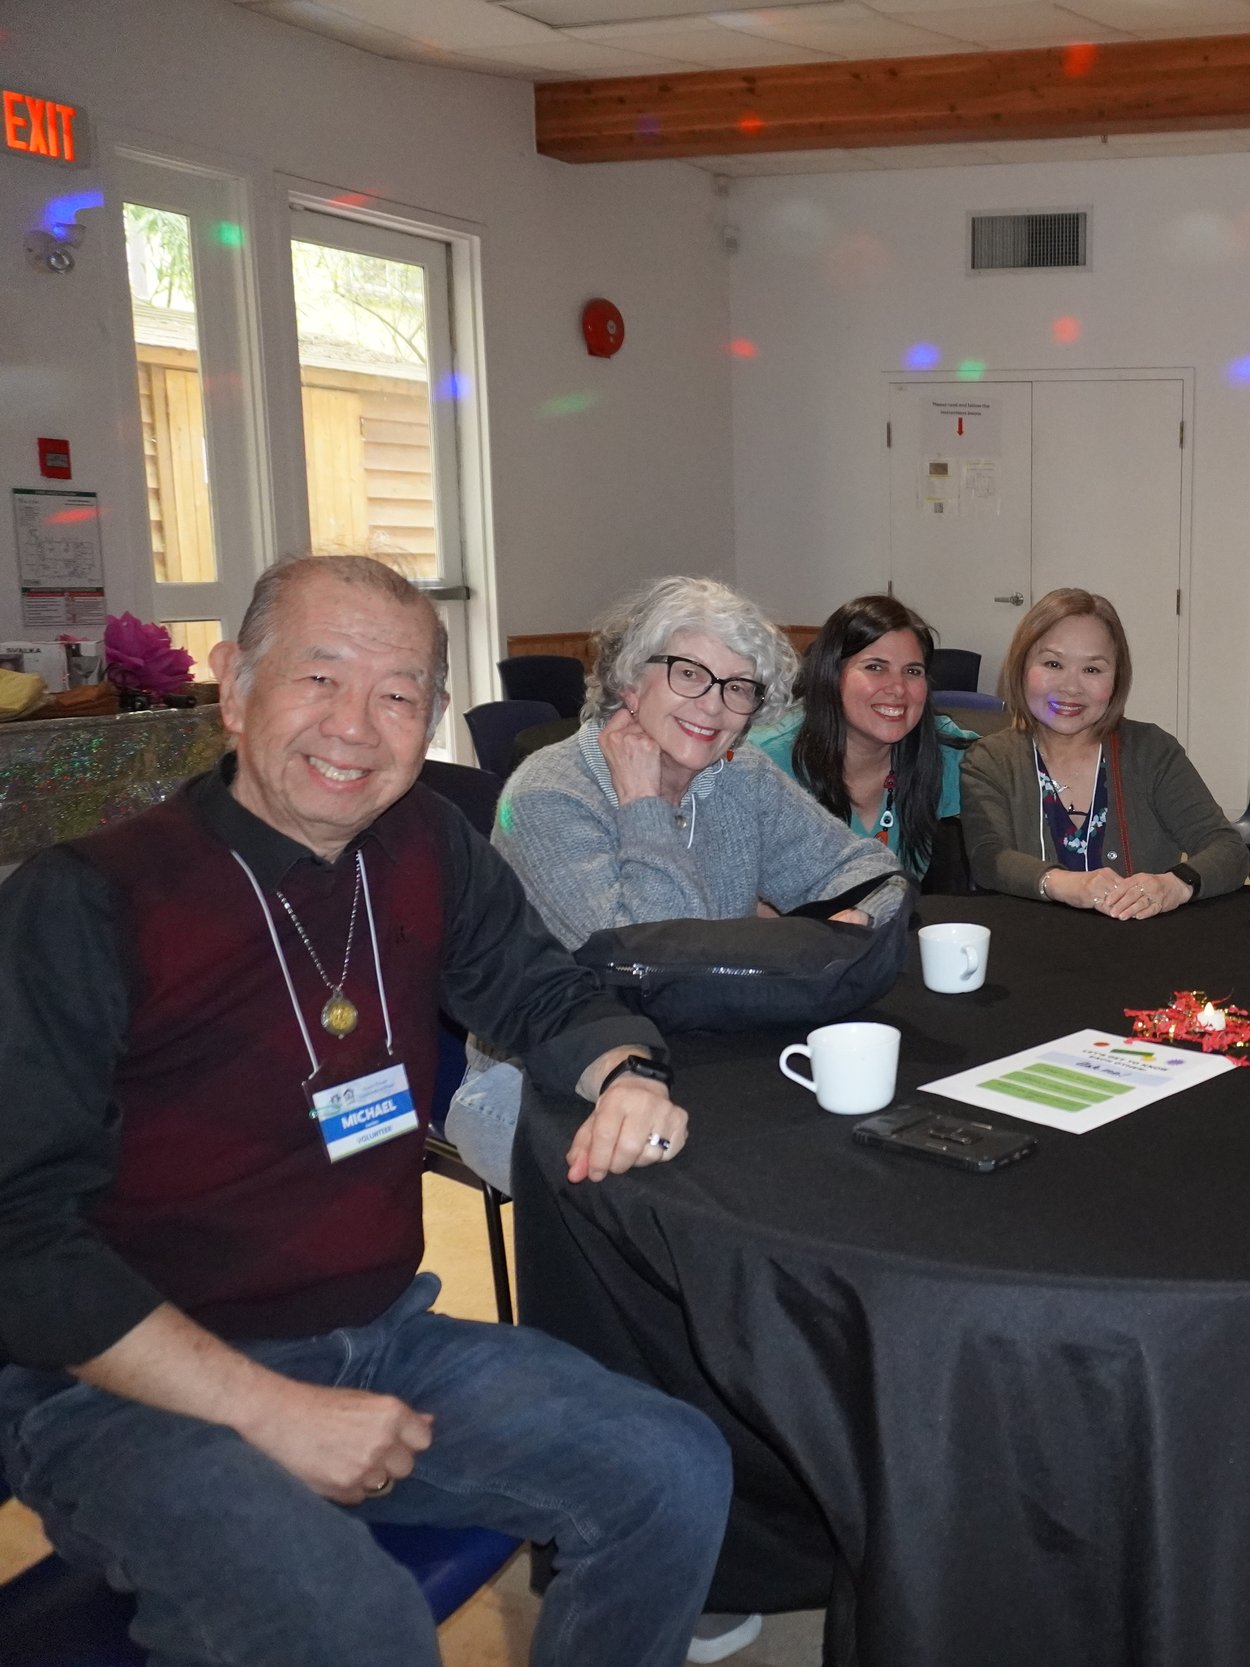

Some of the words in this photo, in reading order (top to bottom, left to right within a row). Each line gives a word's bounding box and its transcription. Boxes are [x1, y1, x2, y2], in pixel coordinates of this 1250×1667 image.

[3, 90, 76, 162] EXIT
[341, 1098, 398, 1130] MICHAEL
[358, 1125, 392, 1144] VOLUNTEER
